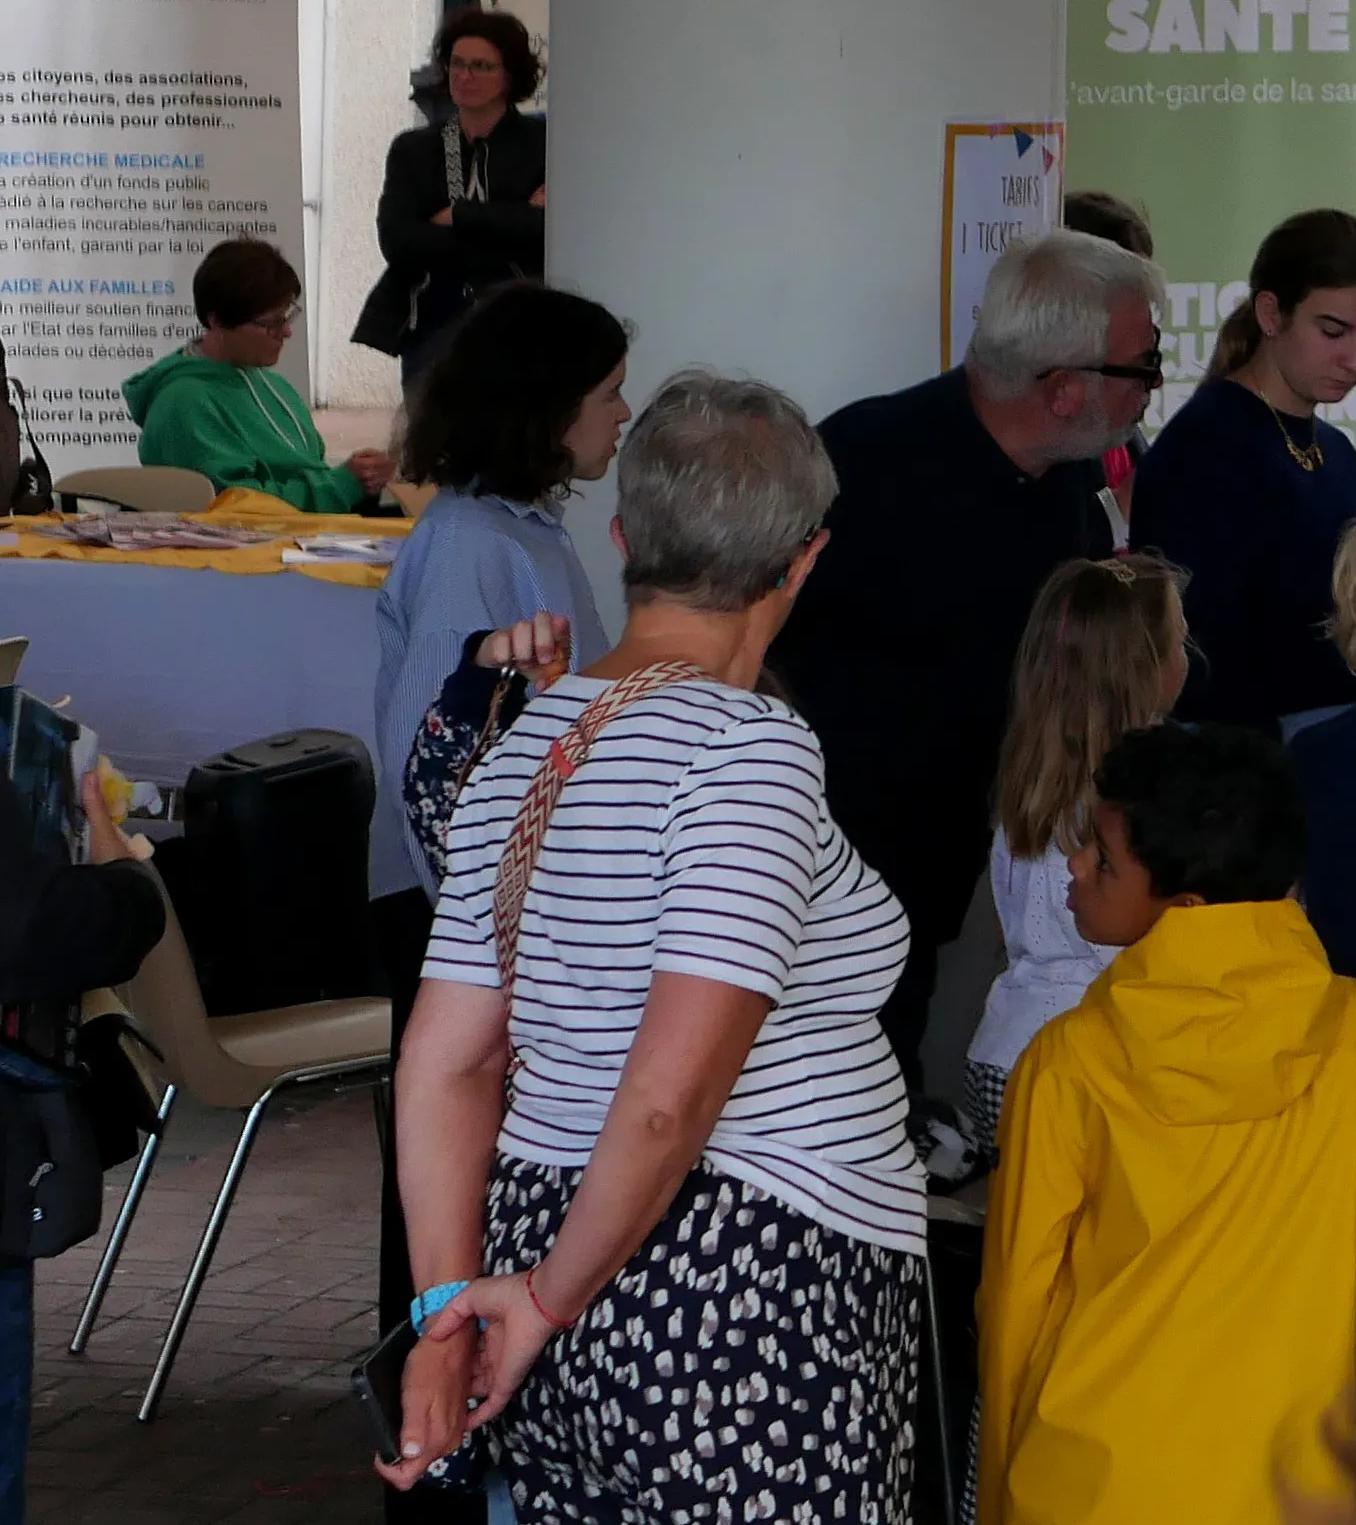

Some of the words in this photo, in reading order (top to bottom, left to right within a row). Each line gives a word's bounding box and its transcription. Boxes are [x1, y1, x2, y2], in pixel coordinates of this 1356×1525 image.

[22, 69, 98, 86] citoyens,
[105, 70, 133, 83] des
[139, 71, 248, 89] associations,
[21, 89, 120, 106] chercheurs,
[125, 92, 155, 105] des
[161, 93, 282, 109] professionnels
[1065, 77, 1246, 111] 'avant-garde
[1252, 78, 1283, 103] de
[1291, 78, 1314, 103] la
[11, 111, 57, 125] santé
[63, 113, 115, 126] réunis
[120, 115, 156, 130] pour
[0, 151, 108, 168] RECHERCHE
[12, 173, 75, 189] création
[80, 175, 112, 189] d'un
[117, 175, 160, 190] fonds
[165, 176, 210, 192] public
[1001, 175, 1040, 207] TARIFS
[37, 194, 46, 209] à
[51, 195, 64, 210] la
[70, 196, 147, 211] recherche
[152, 198, 176, 211] sur
[182, 197, 203, 211] les
[208, 200, 268, 212] cancers
[5, 216, 77, 230] maladies
[80, 238, 133, 255] garanti
[138, 241, 164, 256] par
[169, 238, 183, 253] la
[186, 238, 204, 253] loi
[1, 277, 43, 294] AIDE
[48, 278, 84, 295] AUX
[89, 279, 175, 296] FAMILLES
[19, 300, 81, 316] meilleur
[86, 301, 141, 317] soutien
[66, 321, 94, 337] des
[99, 322, 157, 338] familles
[64, 346, 84, 360] ou
[88, 343, 154, 360] décédés
[42, 387, 73, 403] que
[79, 409, 94, 423] la
[20, 431, 138, 447] ompagneme
